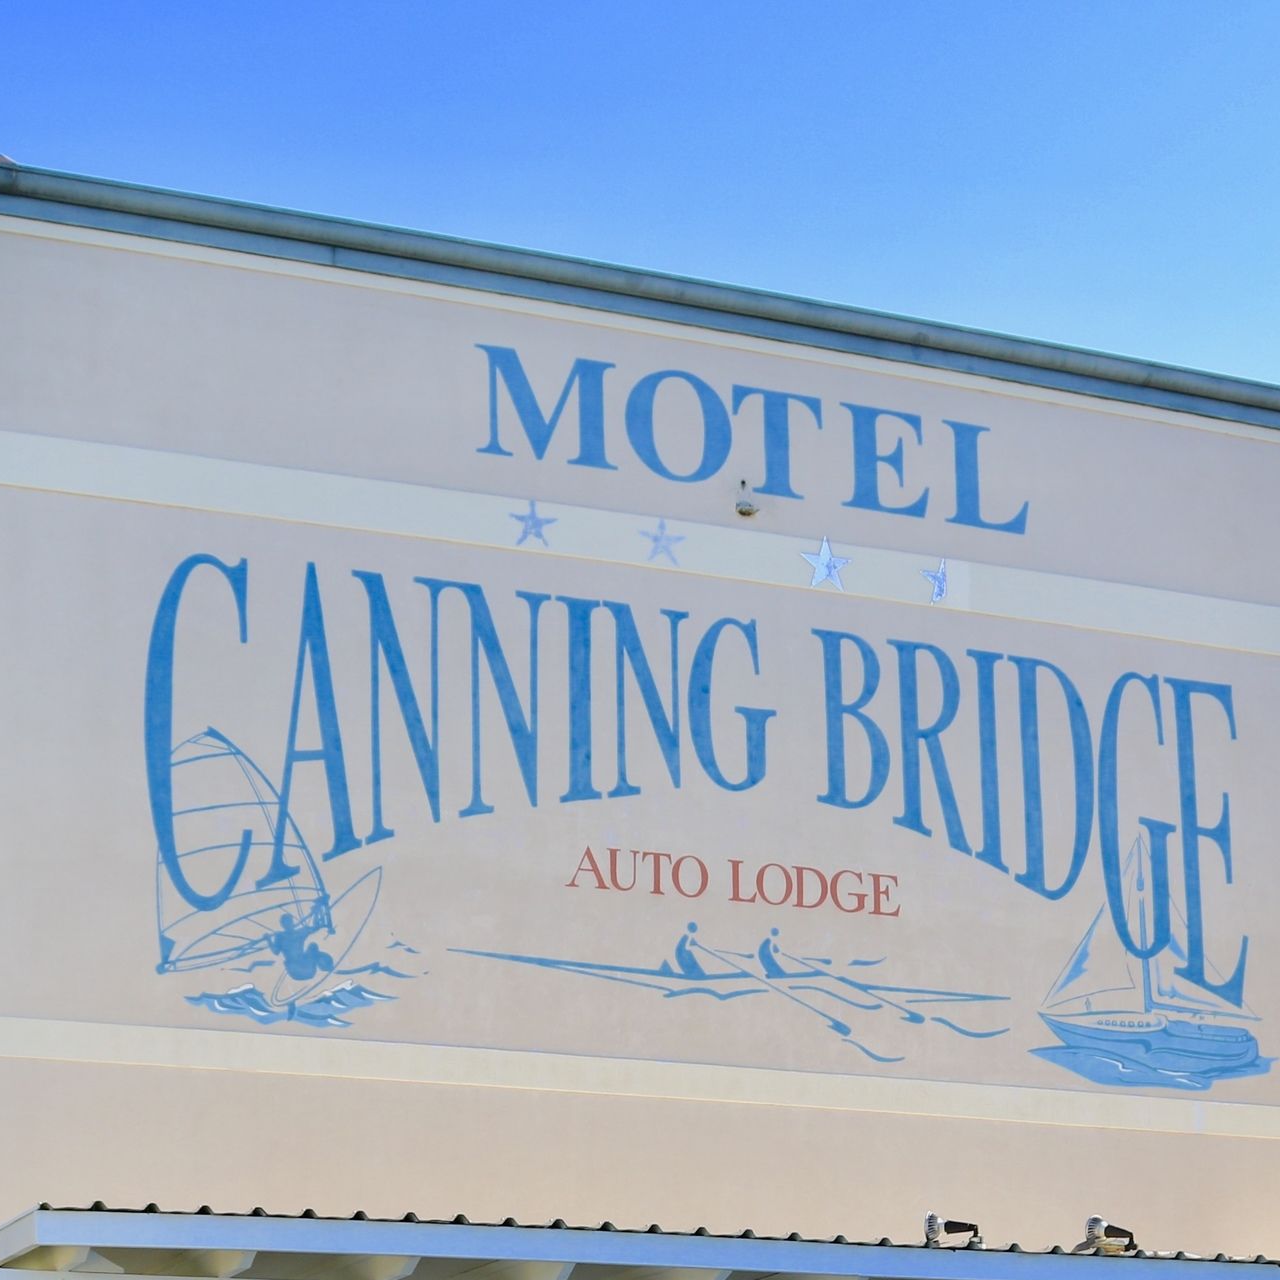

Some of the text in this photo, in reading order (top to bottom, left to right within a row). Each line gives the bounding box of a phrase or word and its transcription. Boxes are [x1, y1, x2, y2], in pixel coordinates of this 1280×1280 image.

[473, 343, 1030, 536] MOTEL
[144, 552, 1250, 1008] CANNING BRIDGE
[566, 845, 903, 918] AUTO LODGE
